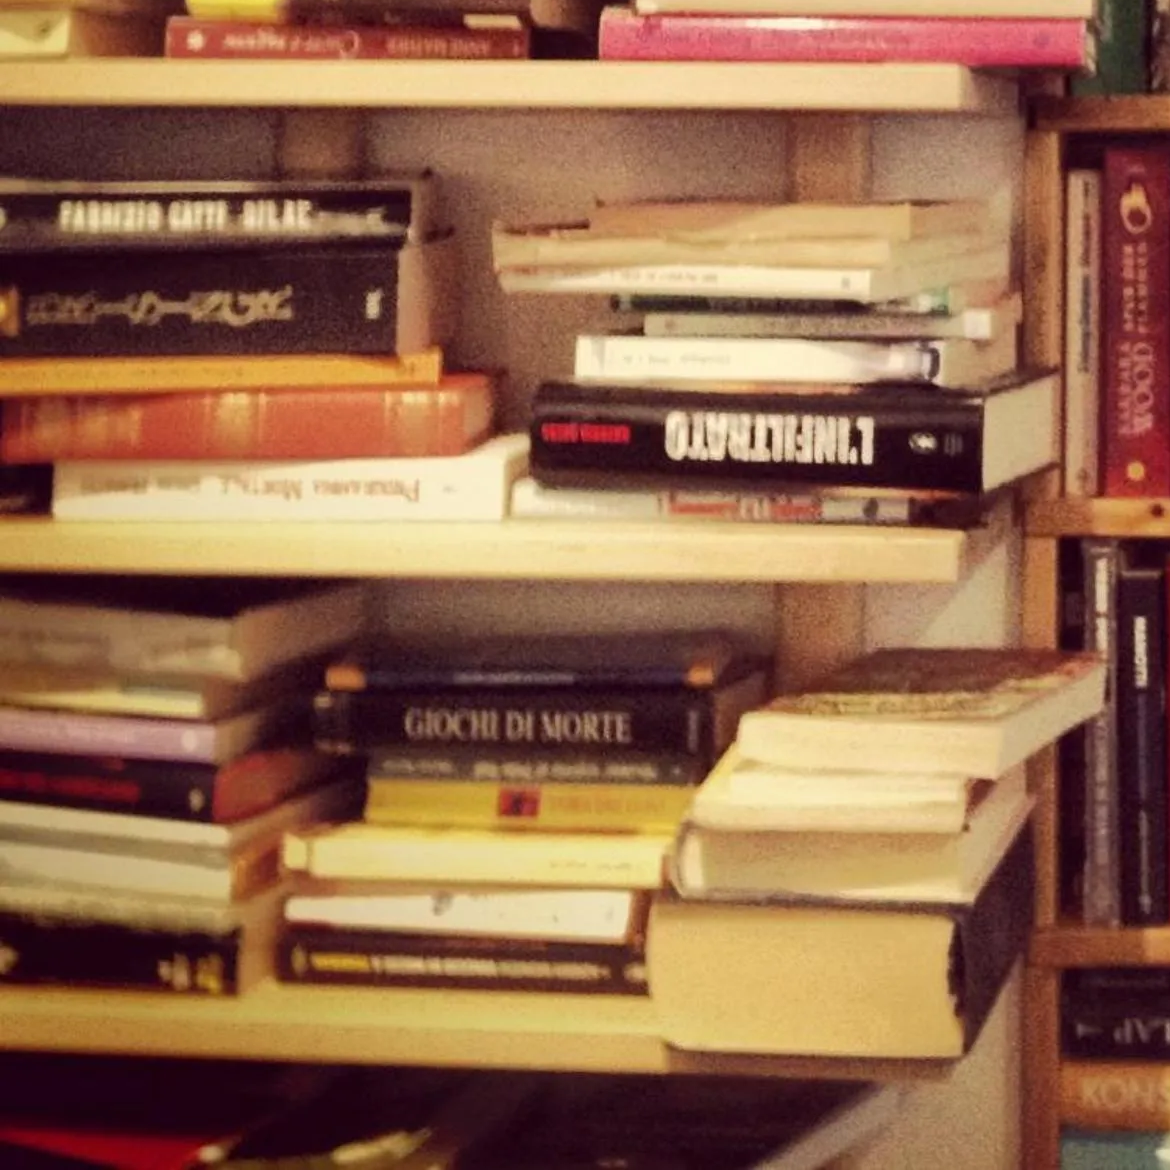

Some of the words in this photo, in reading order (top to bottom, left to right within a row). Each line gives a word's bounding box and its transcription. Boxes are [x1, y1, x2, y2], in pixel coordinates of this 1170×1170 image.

[1131, 341, 1153, 435] WOOD
[664, 409, 874, 465] L'INFILTRATO
[403, 707, 499, 743] GIOCHI
[507, 709, 534, 741] DI
[542, 710, 632, 744] MORTE
